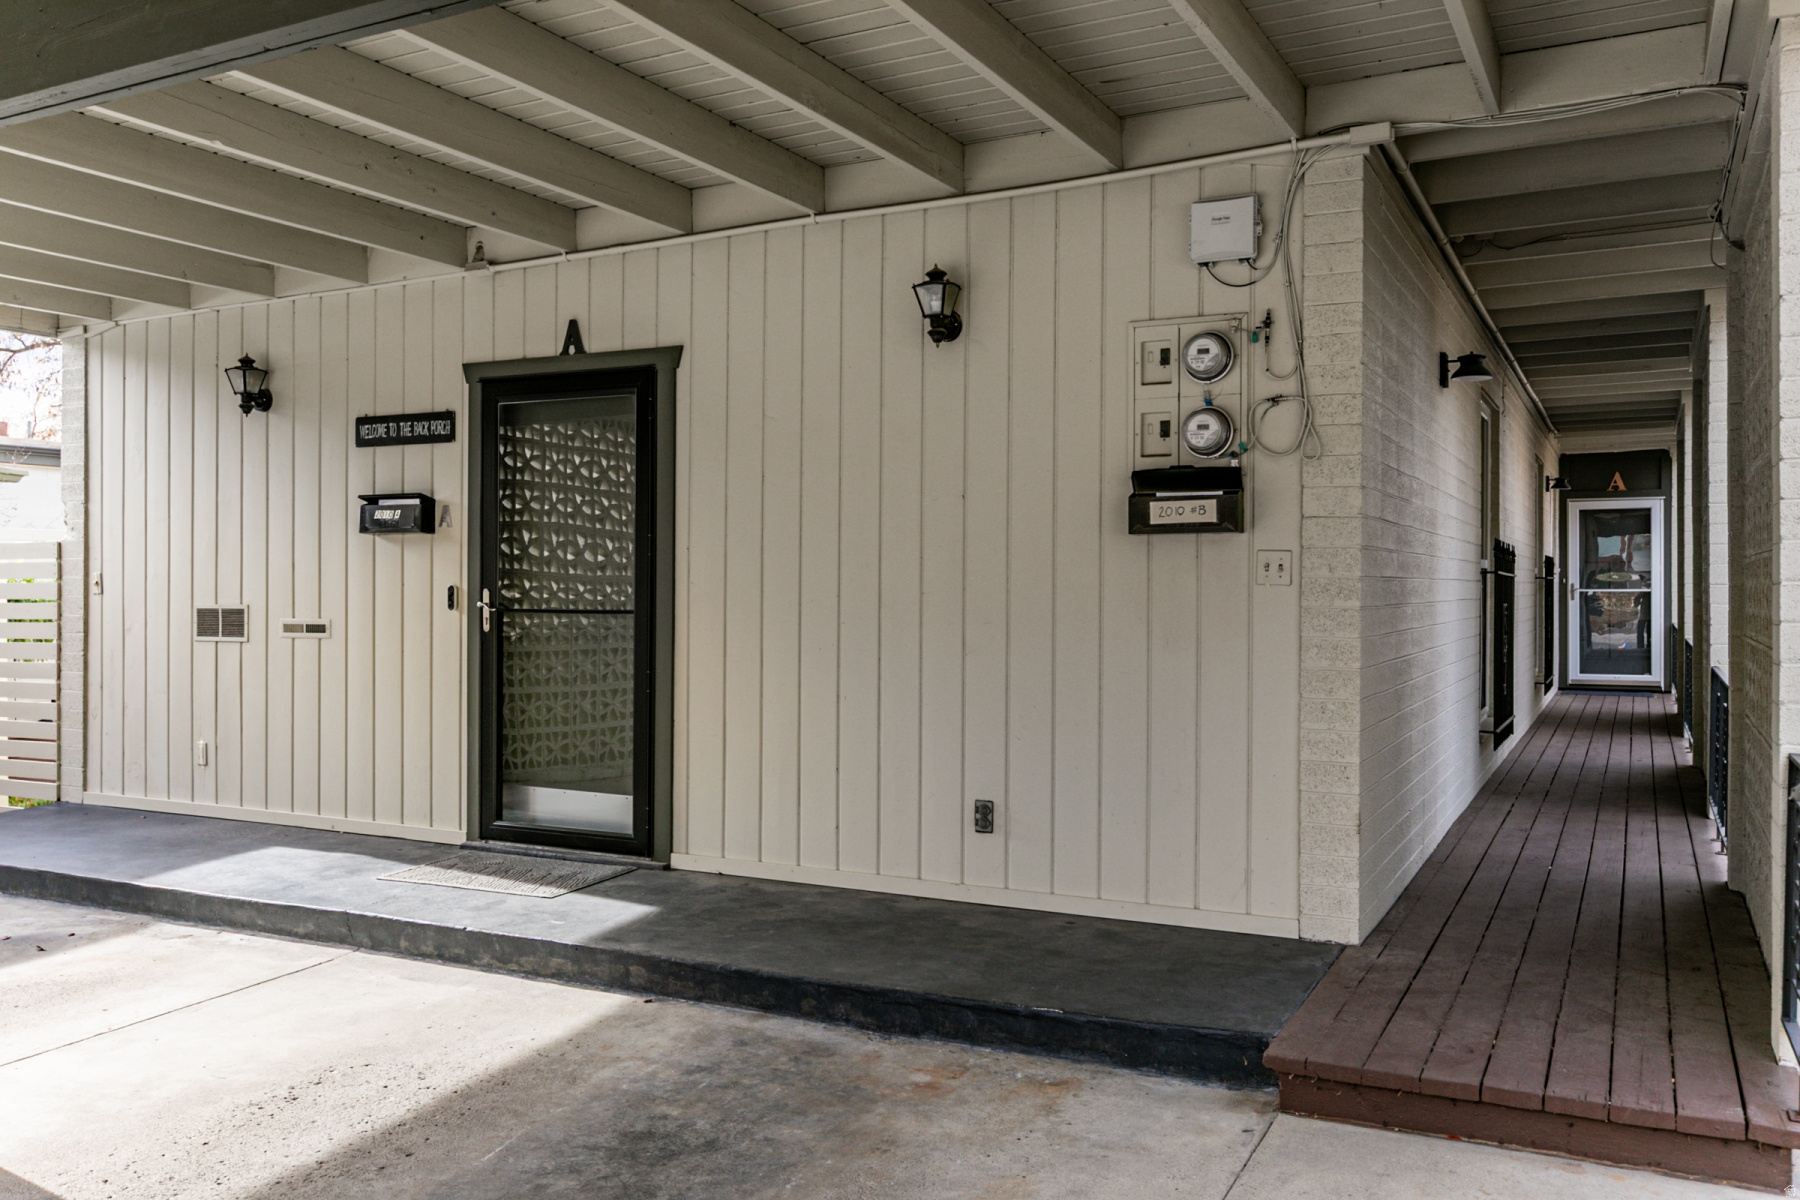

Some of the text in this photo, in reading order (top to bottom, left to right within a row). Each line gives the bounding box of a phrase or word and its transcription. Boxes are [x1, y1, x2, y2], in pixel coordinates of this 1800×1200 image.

[559, 319, 587, 356] A
[359, 420, 451, 439] WELCOME TO THE BACK PORCH
[1606, 471, 1628, 491] A
[438, 505, 453, 528] A
[1158, 505, 1207, 518] 2010 #B
